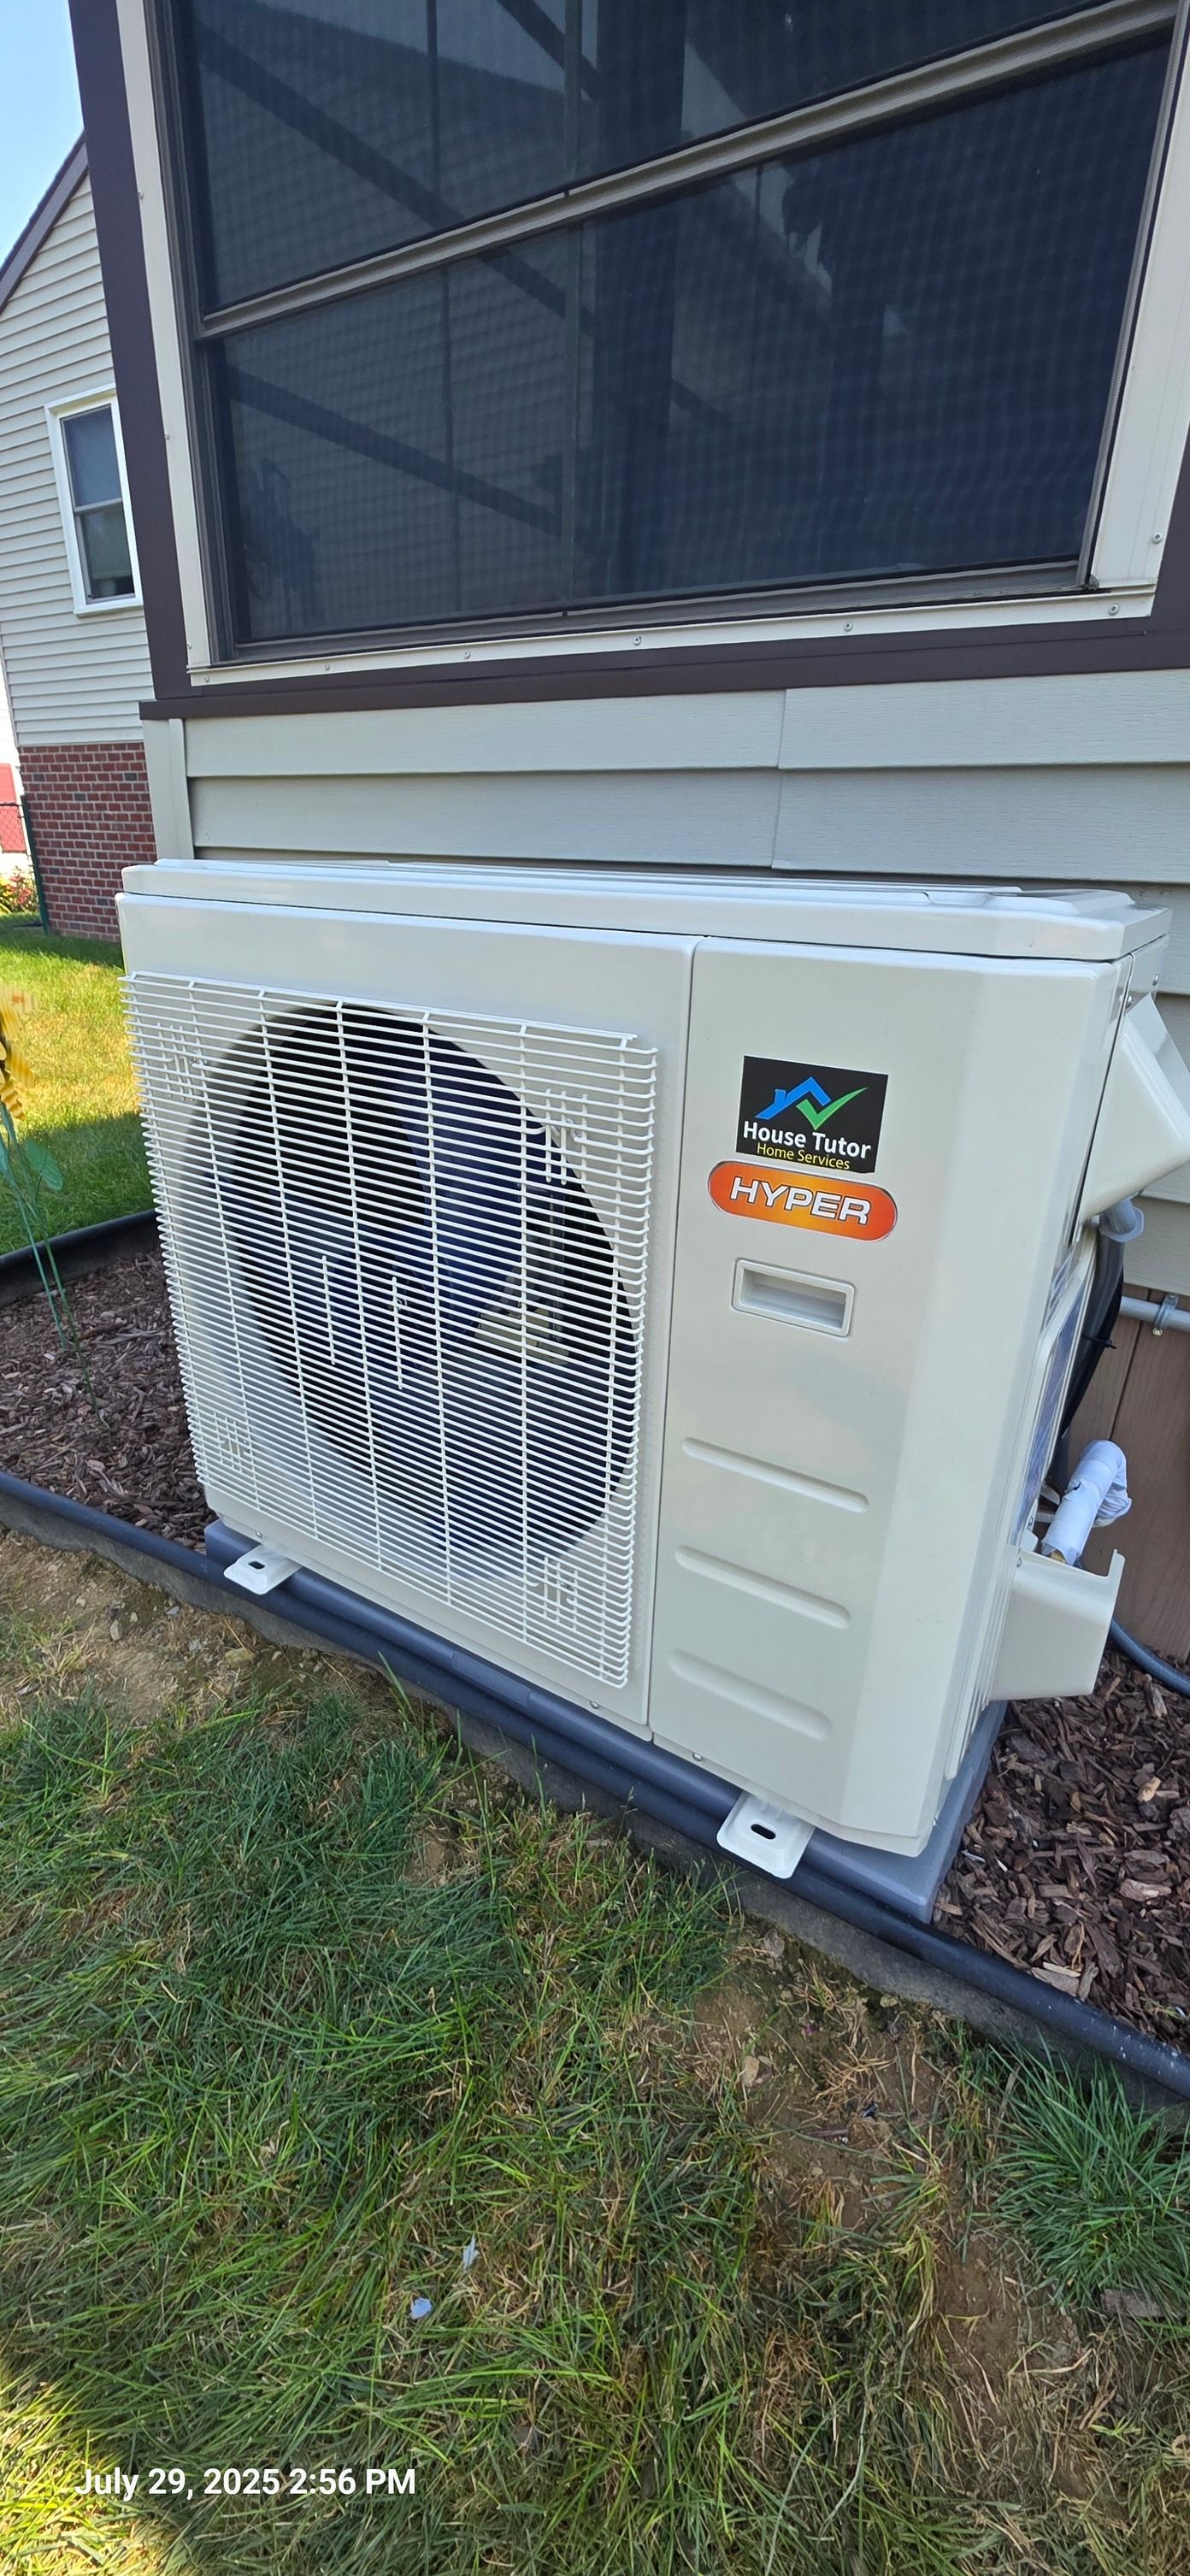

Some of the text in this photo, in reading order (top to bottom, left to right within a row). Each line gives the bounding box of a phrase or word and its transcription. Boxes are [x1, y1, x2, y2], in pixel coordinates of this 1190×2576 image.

[743, 1121, 871, 1158] House Tutor
[757, 1142, 850, 1170] Home Services
[730, 1176, 871, 1225] HYPER
